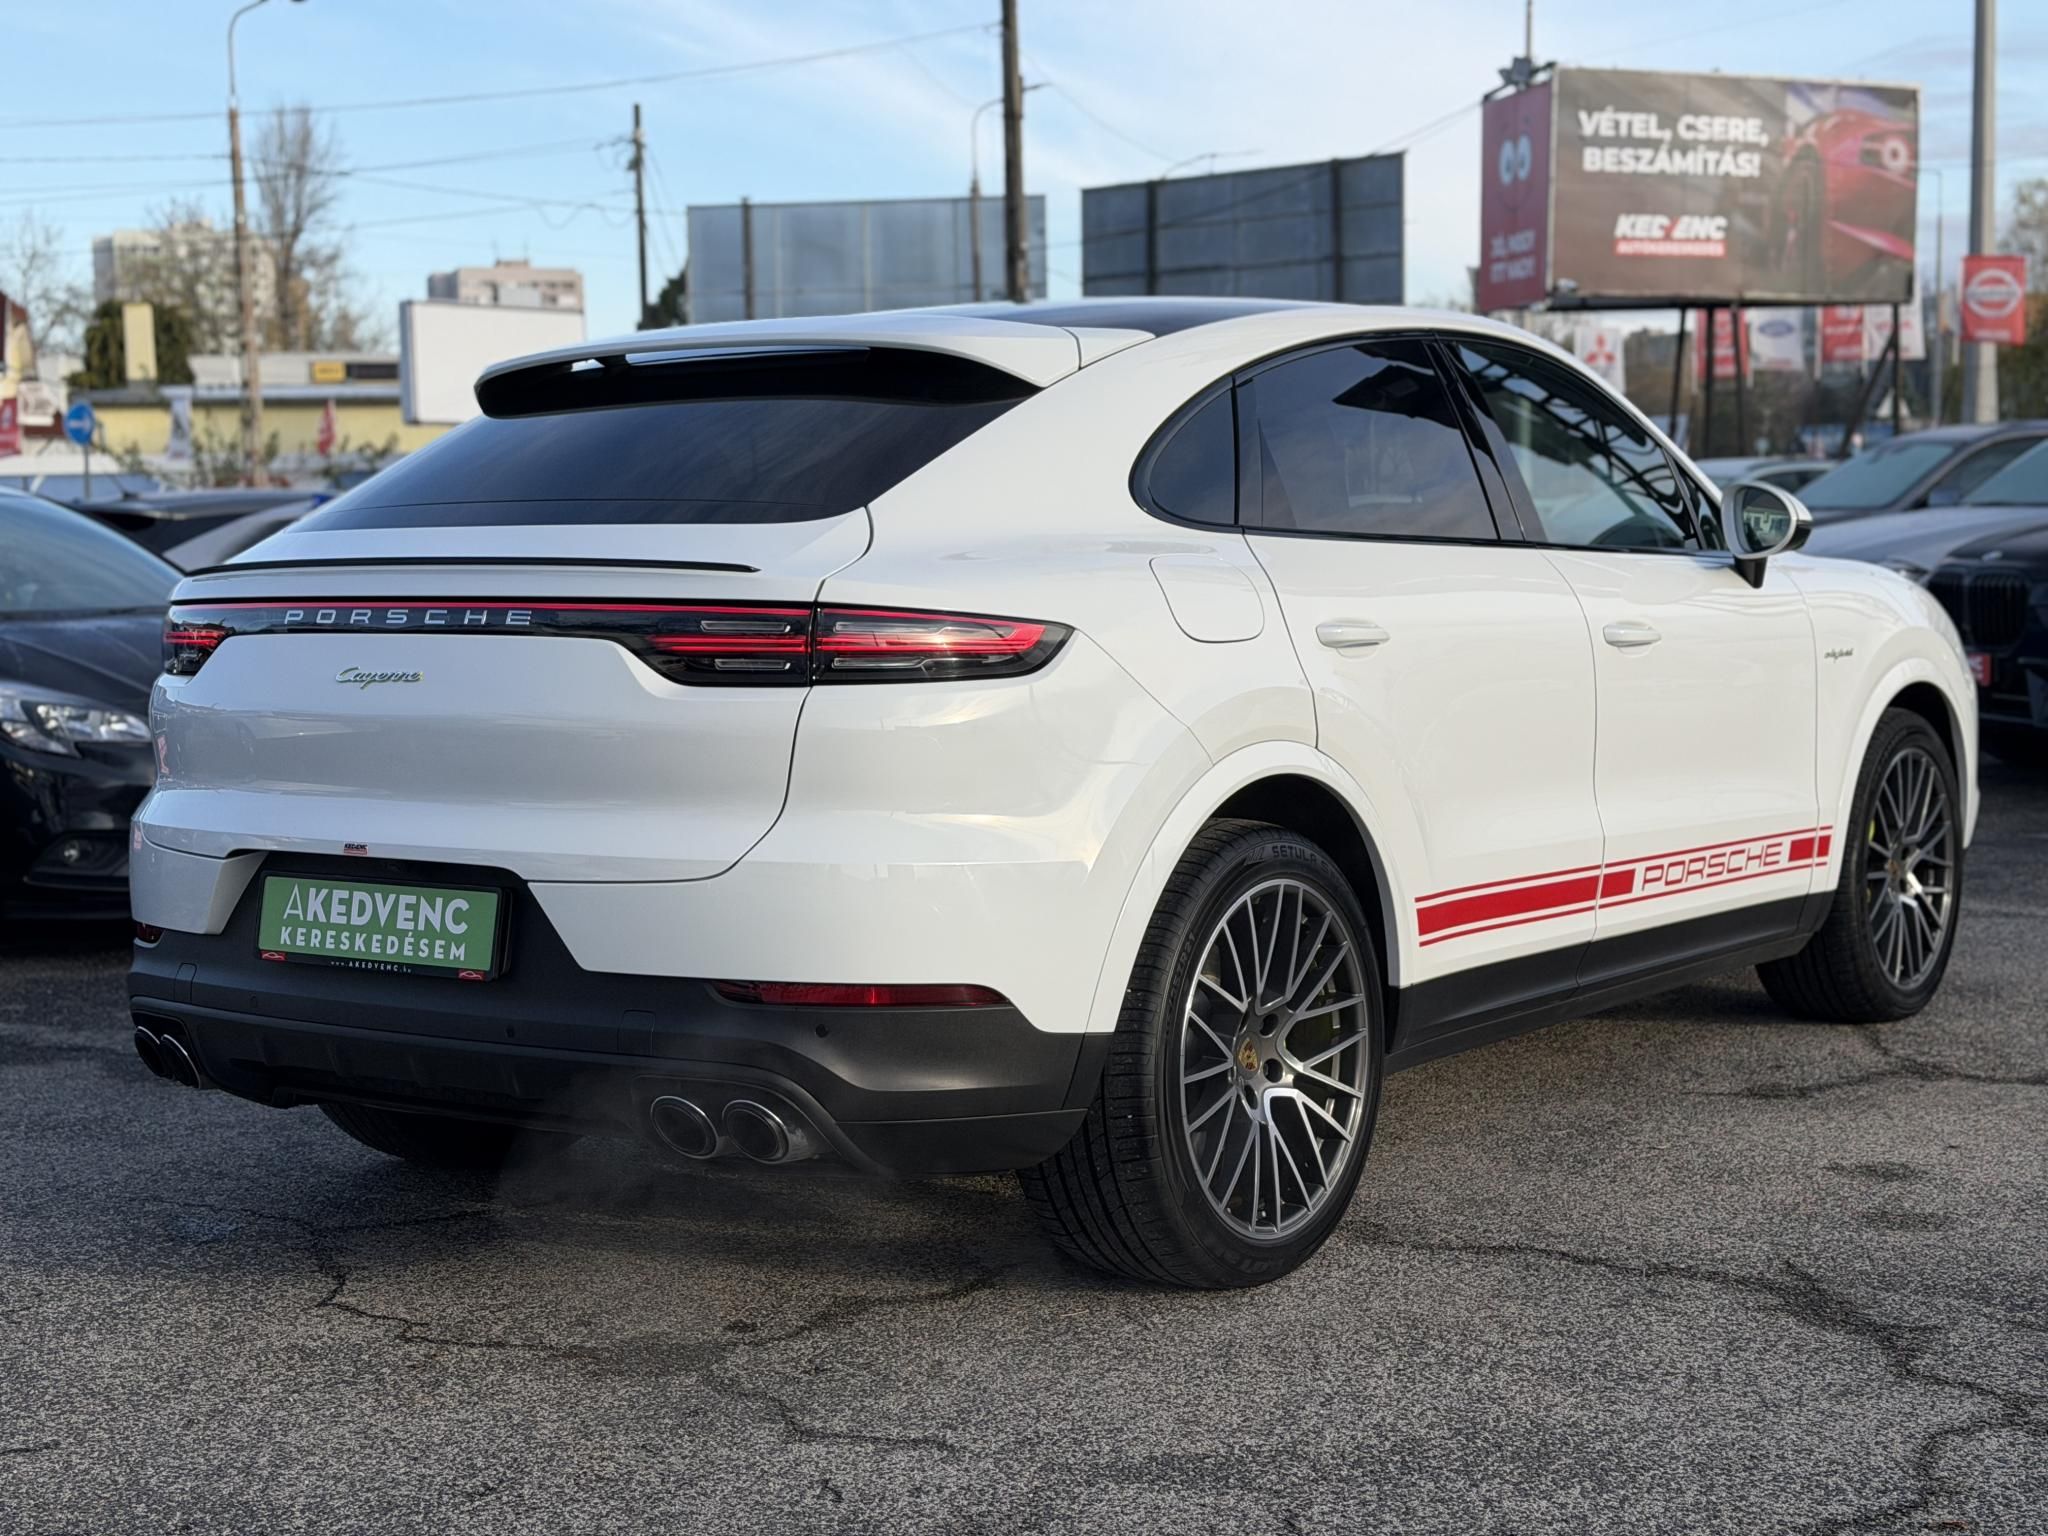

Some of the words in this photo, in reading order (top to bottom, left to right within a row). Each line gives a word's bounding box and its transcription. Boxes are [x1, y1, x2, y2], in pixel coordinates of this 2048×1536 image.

[1578, 106, 1672, 142] VÉTEL,
[1677, 114, 1769, 147] CSERE,
[1583, 144, 1761, 178] BESZÁMÍTÁS!
[284, 609, 532, 626] PORSCHE
[336, 666, 424, 690] Cayenne
[1272, 844, 1317, 866] SETULA
[1642, 842, 1783, 891] PORSCHE
[280, 926, 466, 961] KERESKEDÉSEM
